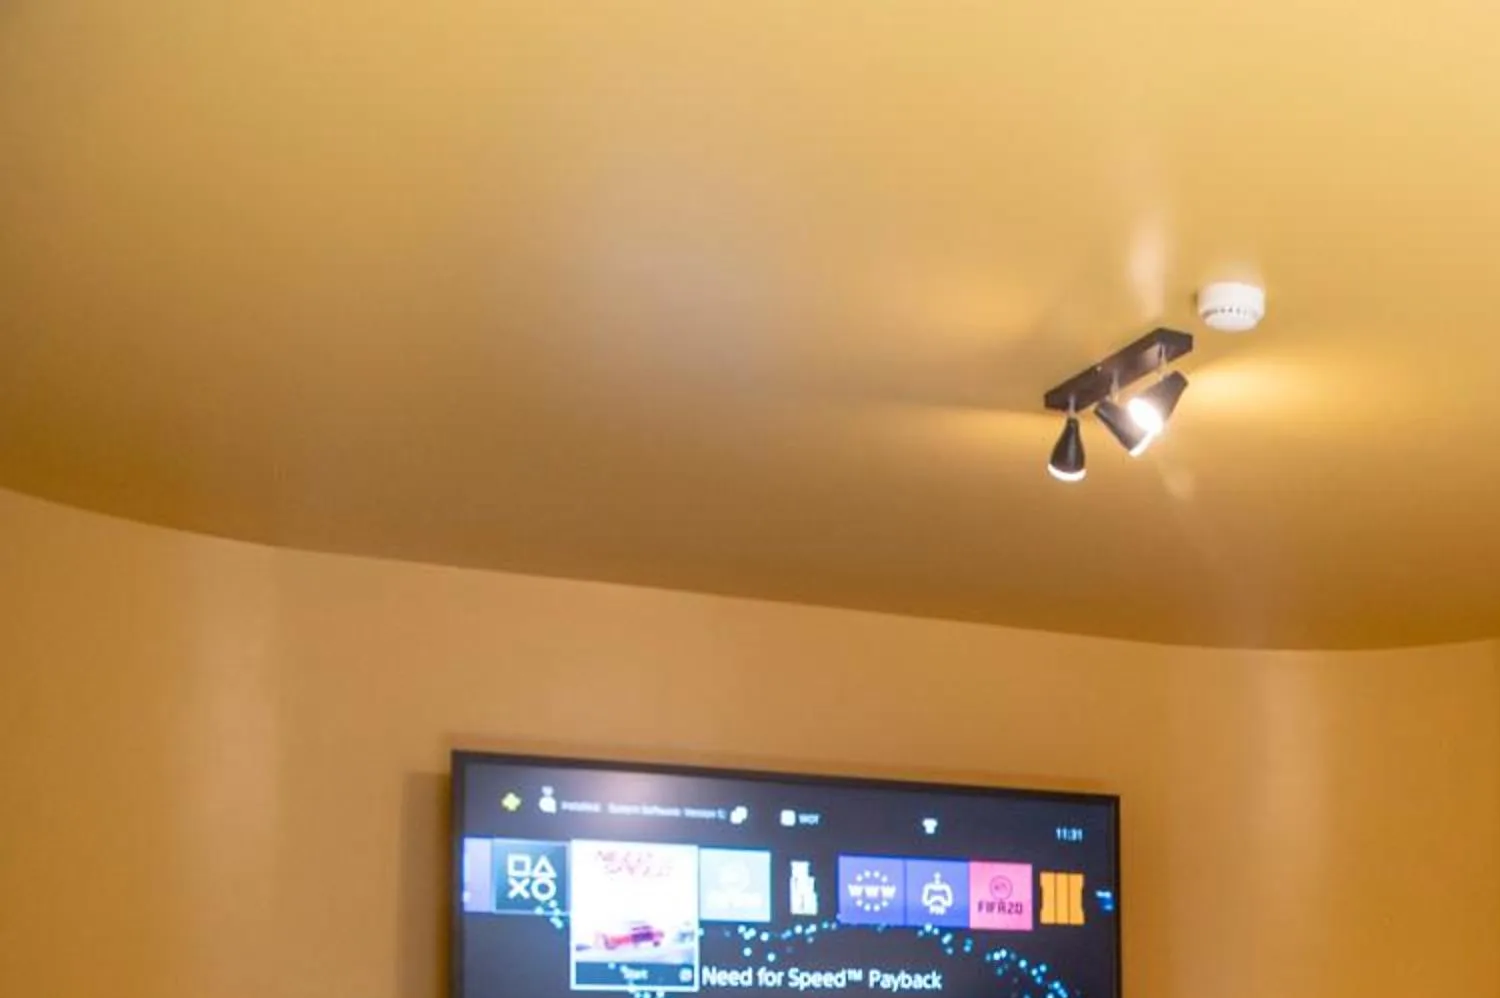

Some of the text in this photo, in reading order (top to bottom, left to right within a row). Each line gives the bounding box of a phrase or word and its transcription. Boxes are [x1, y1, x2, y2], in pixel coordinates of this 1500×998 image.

[702, 966, 753, 987] Need
[757, 967, 785, 988] for
[868, 969, 943, 992] Payback
